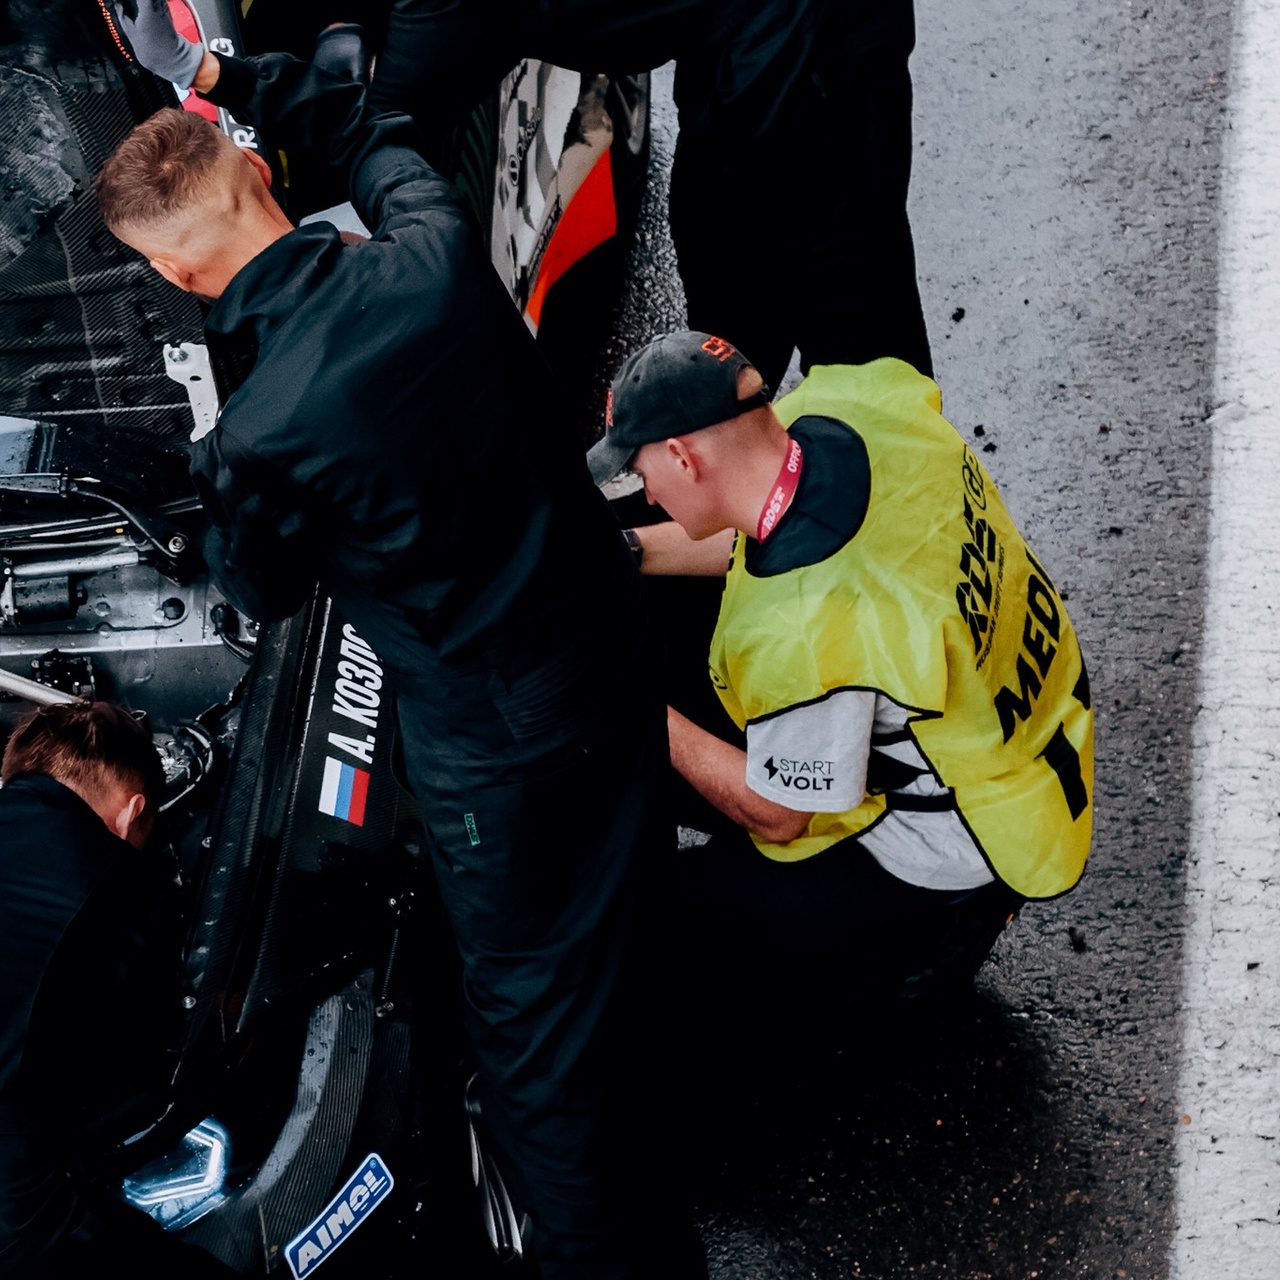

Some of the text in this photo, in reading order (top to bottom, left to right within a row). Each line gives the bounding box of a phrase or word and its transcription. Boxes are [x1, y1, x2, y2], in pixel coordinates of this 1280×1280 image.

[994, 545, 1061, 746] MEDI
[326, 731, 377, 765] А.
[779, 758, 835, 775] START
[779, 773, 835, 791] VOLT
[298, 1169, 389, 1274] AIMOL
